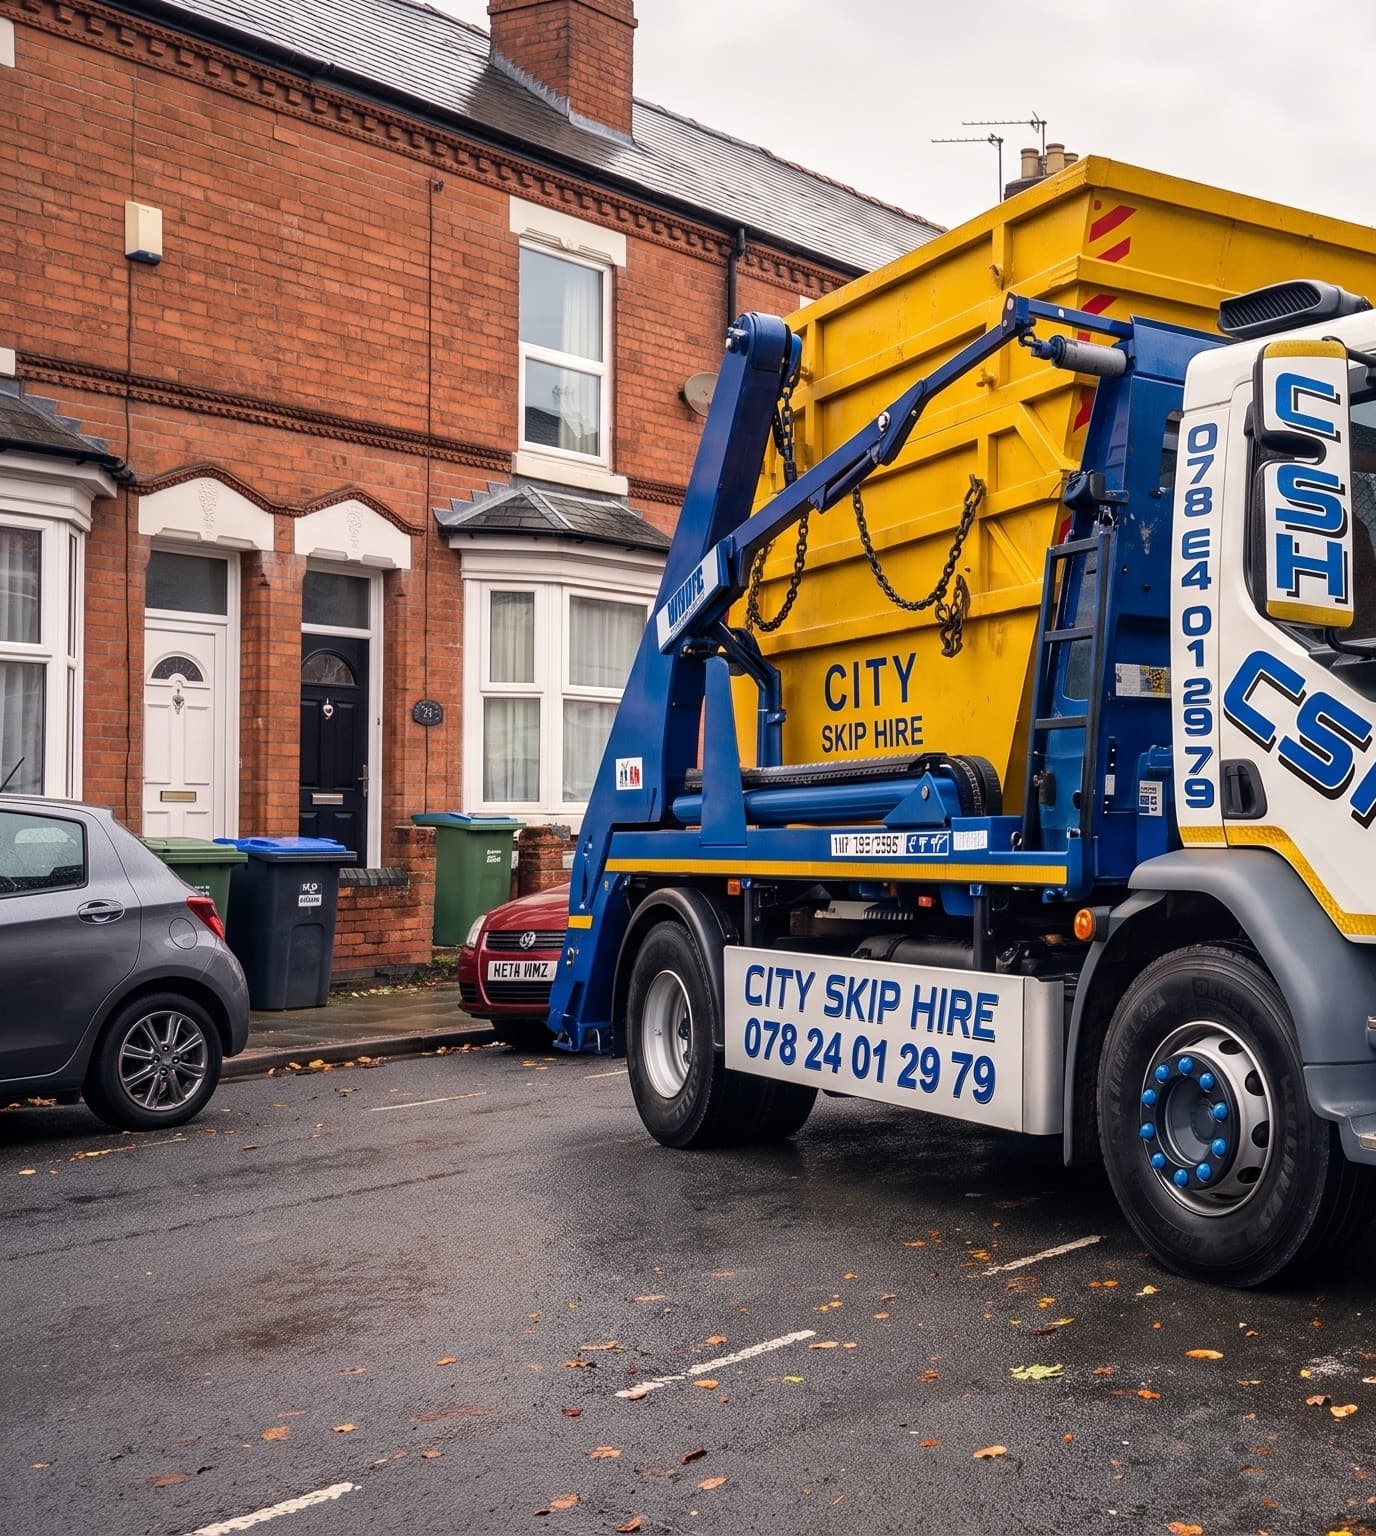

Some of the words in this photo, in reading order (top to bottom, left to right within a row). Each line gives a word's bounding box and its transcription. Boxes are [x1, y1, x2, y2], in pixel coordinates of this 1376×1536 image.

[1184, 422, 1218, 518] 078
[1275, 372, 1348, 604] CSH
[1182, 605, 1212, 668] 01
[825, 652, 917, 712] CITY
[1183, 677, 1213, 737] 29
[822, 722, 866, 753] SKIP
[874, 715, 923, 749] HIRE
[1184, 746, 1215, 809] 79
[745, 964, 816, 1012] CITY
[823, 974, 901, 1025] SKIP
[910, 984, 999, 1043] HIRE
[744, 1017, 798, 1066] 078
[804, 1027, 842, 1074] 24
[851, 1035, 888, 1083] 01
[896, 1043, 941, 1094] 29
[951, 1051, 996, 1105] 79
